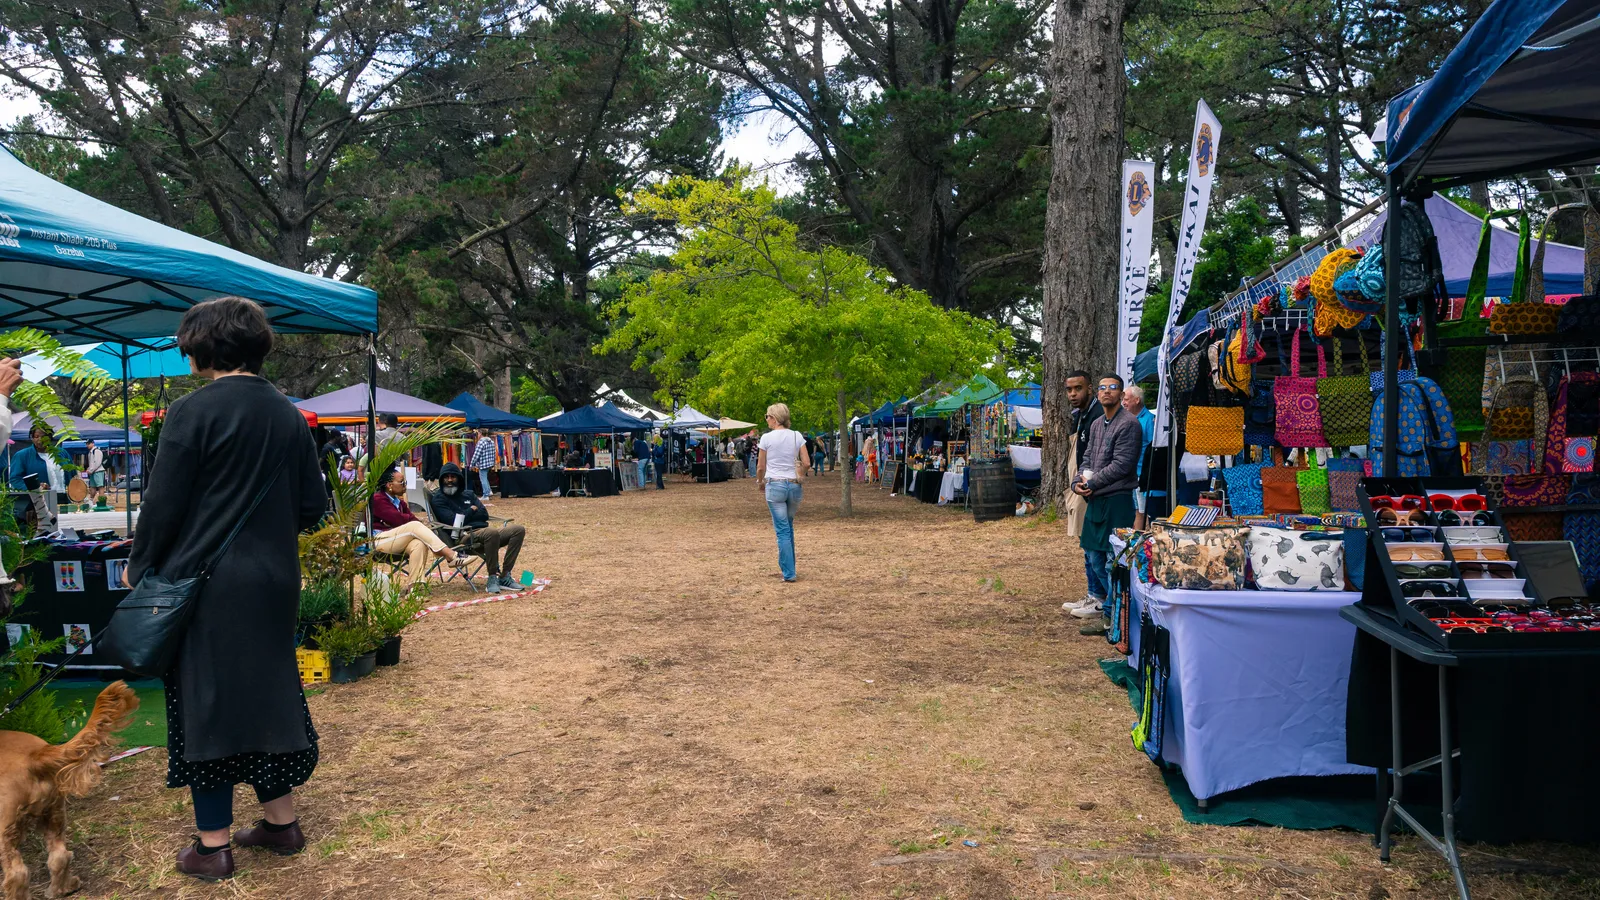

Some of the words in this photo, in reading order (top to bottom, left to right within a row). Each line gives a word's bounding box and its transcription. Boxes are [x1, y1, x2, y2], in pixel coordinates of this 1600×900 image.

[30, 228, 59, 242] Instant
[60, 232, 84, 246] Shade
[85, 235, 100, 249] 205
[101, 238, 118, 251] Plus
[54, 244, 85, 257] Gazebo
[1128, 266, 1146, 343] SERVE
